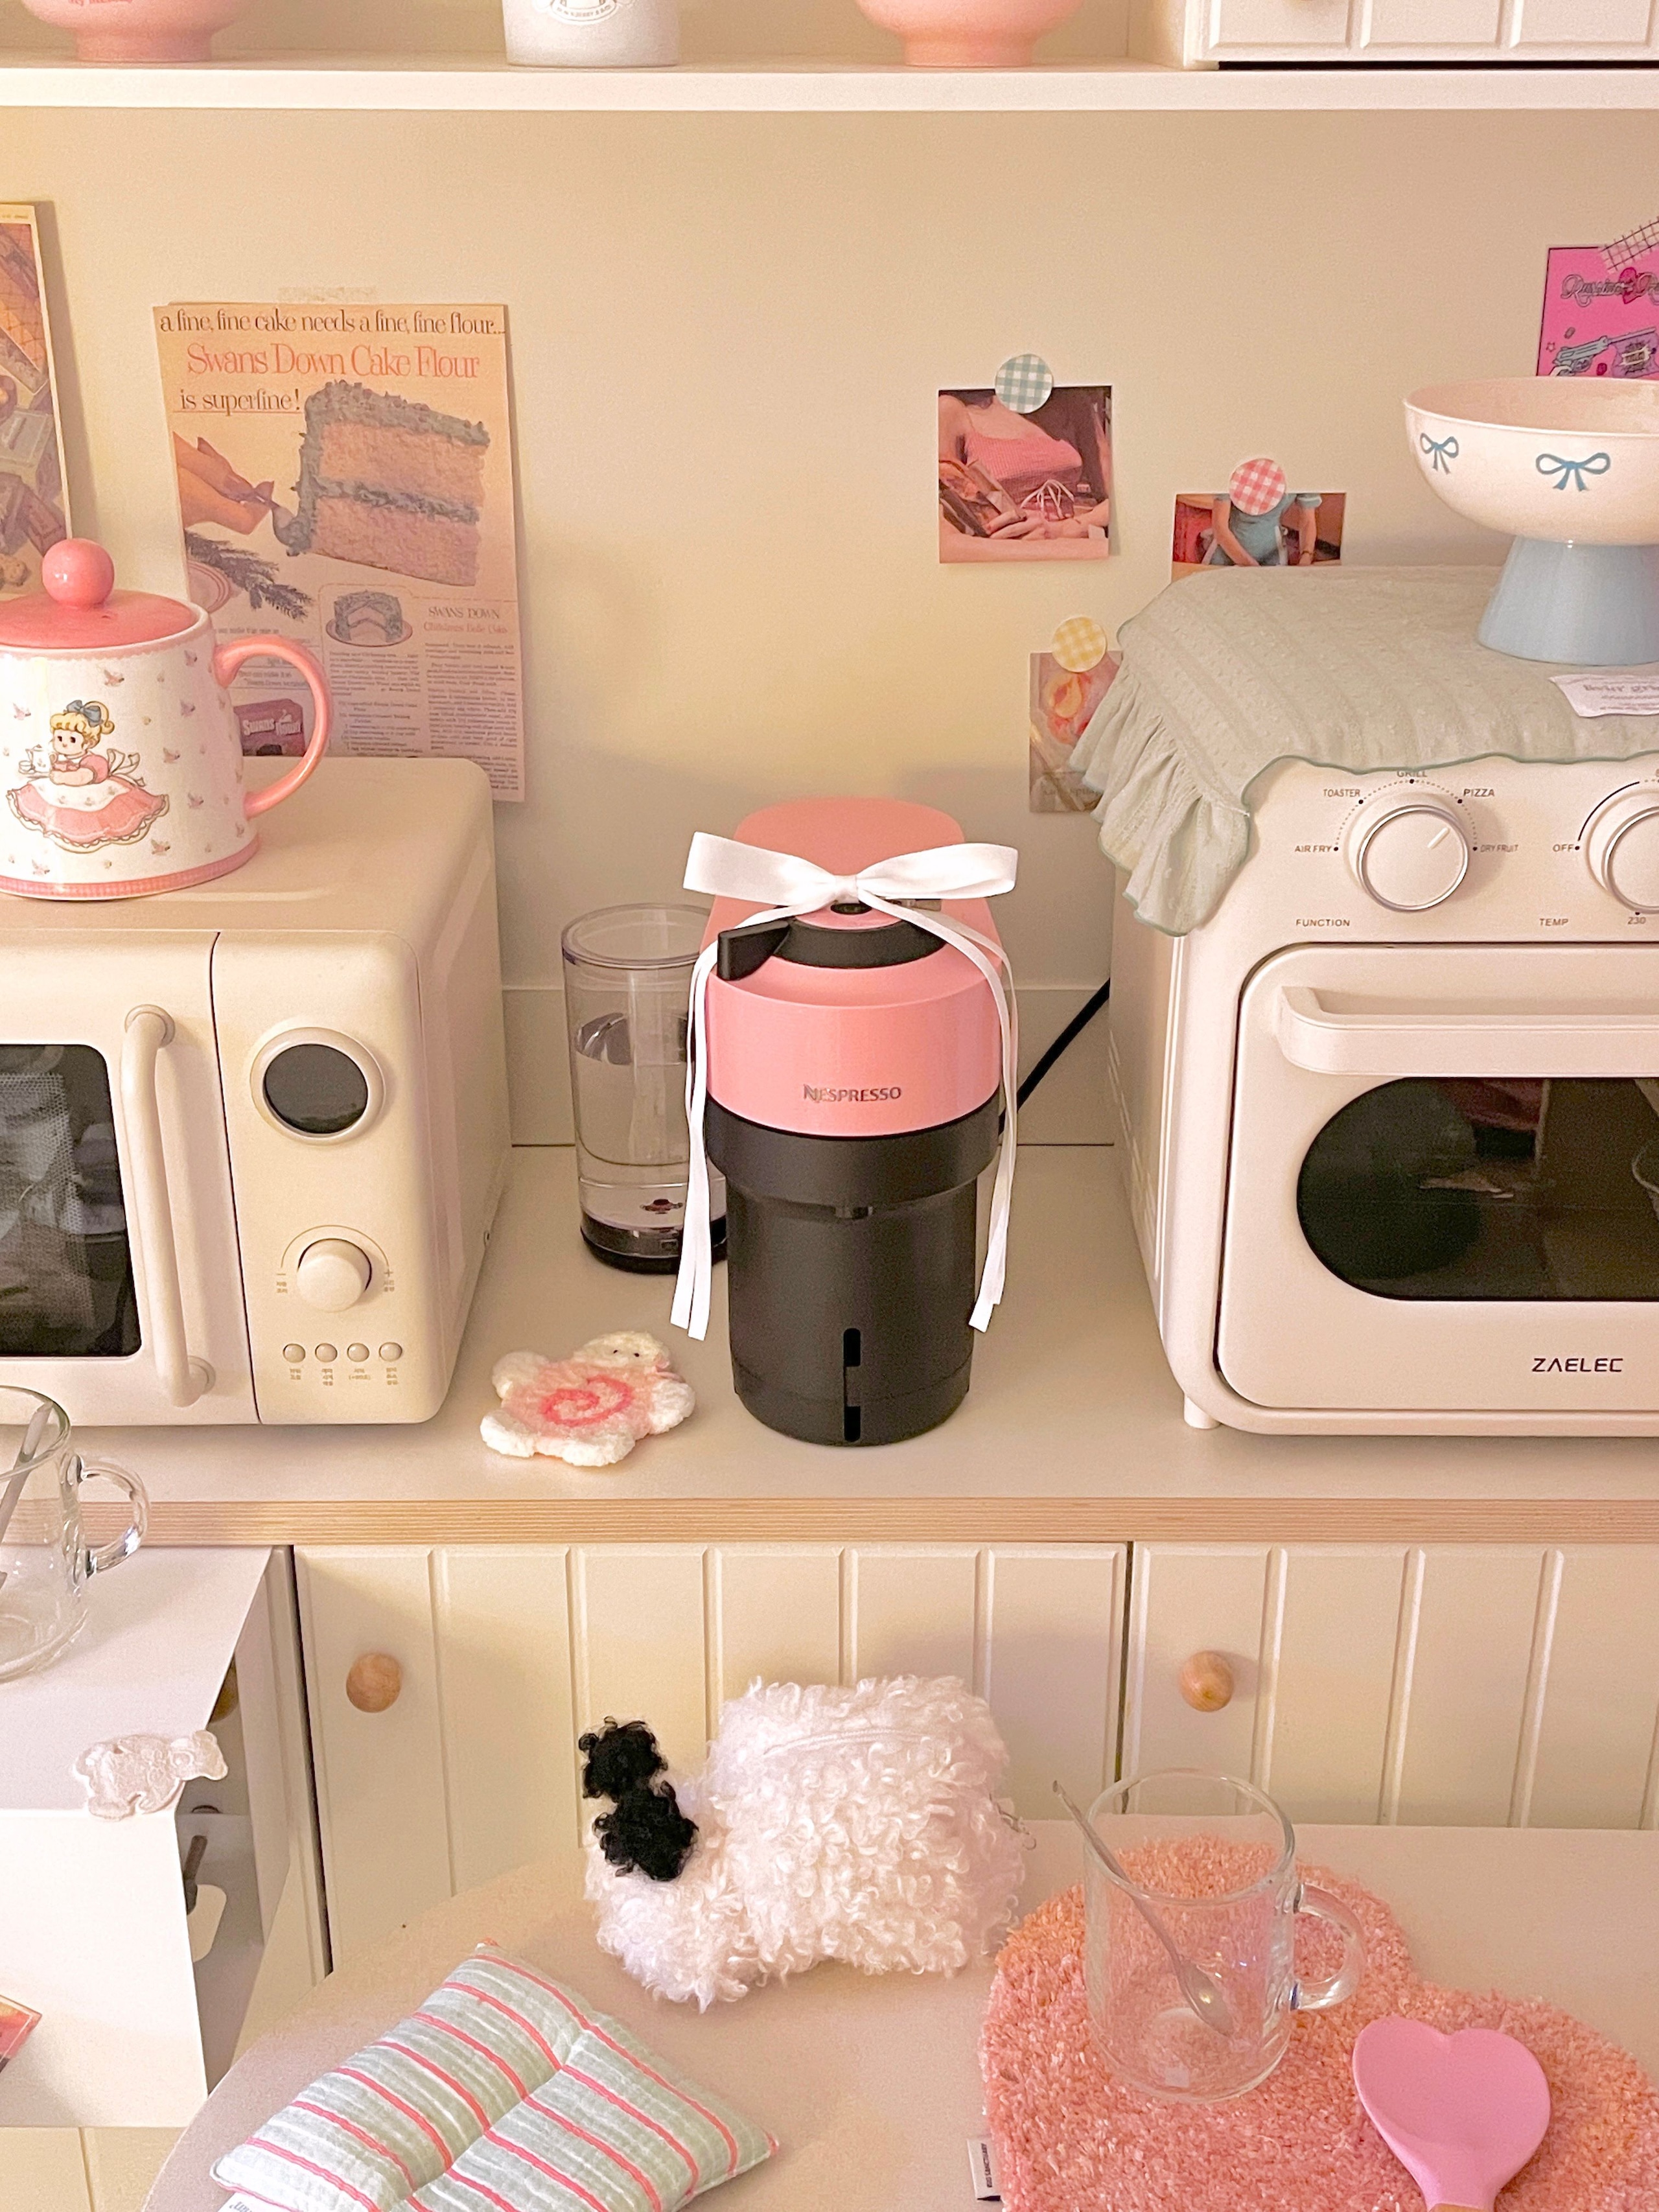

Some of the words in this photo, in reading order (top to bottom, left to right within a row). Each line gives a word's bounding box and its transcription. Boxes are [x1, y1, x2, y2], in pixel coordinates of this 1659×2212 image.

[160, 316, 172, 332] a
[178, 309, 214, 332] fine,
[217, 309, 251, 331] fine
[255, 308, 296, 332] cake
[301, 309, 354, 333] needs
[359, 316, 373, 332] a
[376, 309, 410, 334] fine,
[413, 310, 446, 334] fine
[187, 342, 268, 375] Swans
[270, 343, 347, 375] Down
[351, 344, 412, 377] Cake
[413, 345, 480, 378] Flour
[180, 390, 196, 410] is
[202, 388, 300, 416] superfine!
[1323, 789, 1360, 797] TOASTER
[1463, 788, 1494, 797] PIZZA
[1496, 844, 1518, 853] FRUIT
[1552, 844, 1574, 852] OFF
[1295, 918, 1350, 927] FUNCTION
[1539, 918, 1568, 926] TEMP
[1627, 916, 1647, 926] 230
[803, 1084, 902, 1102] NESPRESSO
[1531, 1357, 1623, 1373] ZAELEC
